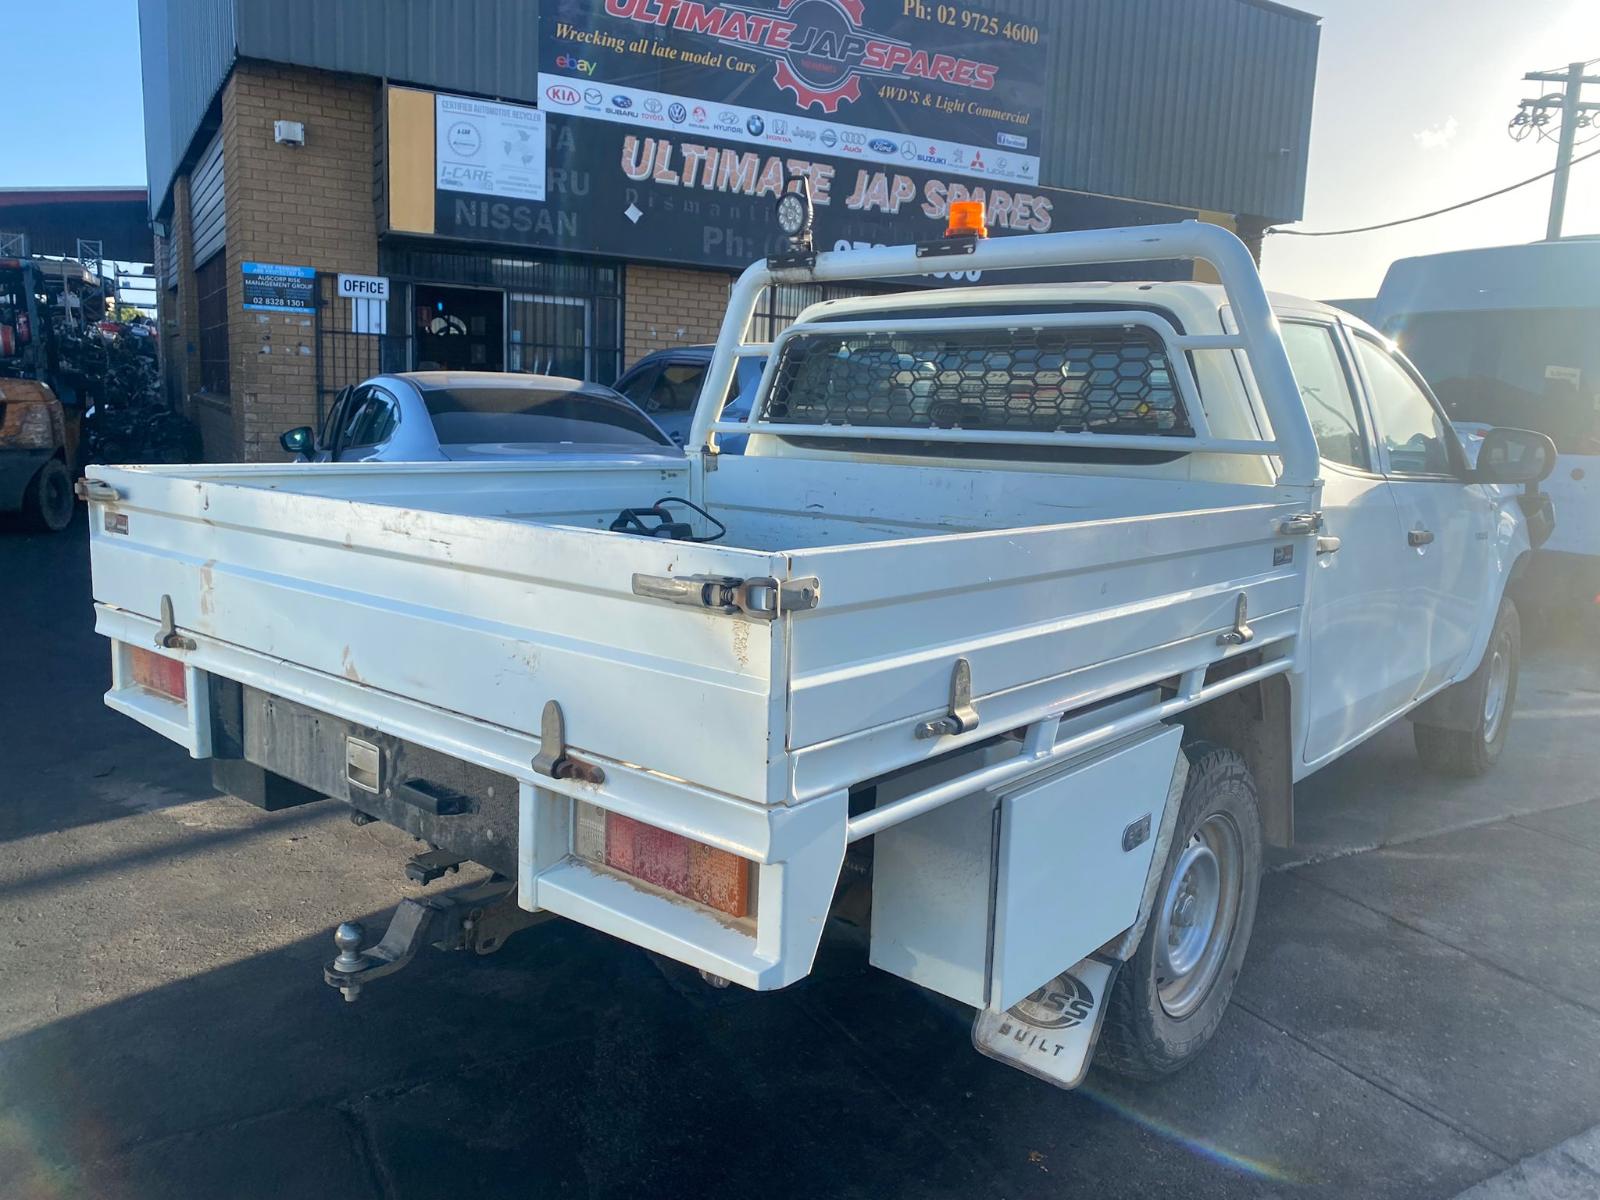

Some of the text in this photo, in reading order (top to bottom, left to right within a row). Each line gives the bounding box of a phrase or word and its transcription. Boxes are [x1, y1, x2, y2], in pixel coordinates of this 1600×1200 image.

[903, 0, 1038, 45] Ph: 02 9725 4600
[556, 23, 757, 74] Wrecking all late model Cars
[604, 0, 999, 91] ULTIMATE JAP SPARES
[556, 52, 597, 76] ebay
[552, 88, 576, 102] KIA
[605, 107, 639, 118] SUBARU
[641, 113, 665, 122] TOYOTA
[922, 95, 932, 106] &
[936, 95, 966, 114] Light
[967, 102, 1030, 126] Commercial
[791, 126, 817, 141] Jeep
[842, 144, 863, 153] Audi
[873, 142, 893, 153] Ford
[917, 155, 947, 165] SUZUKI
[621, 135, 836, 206] ULTIMATE
[845, 169, 917, 215] JAP
[455, 198, 578, 237] NISSAN
[245, 279, 313, 290] MANAGEMENT GROUP
[344, 279, 385, 294] OFFICE
[252, 296, 305, 307] 02 8328 1301
[998, 1022, 1065, 1057] BUILT
